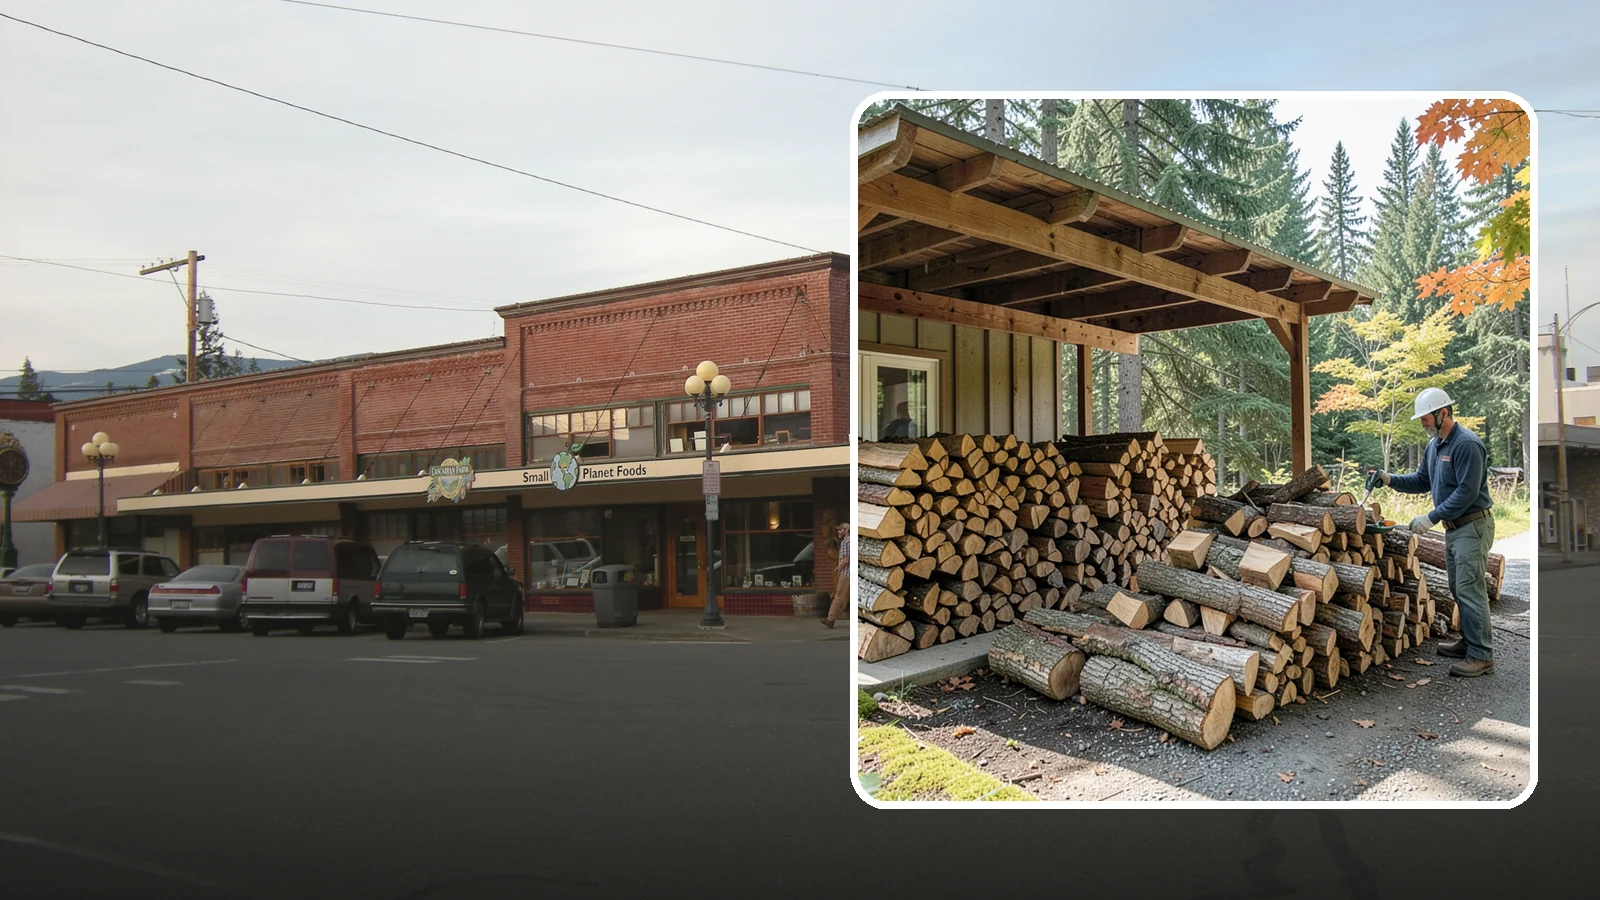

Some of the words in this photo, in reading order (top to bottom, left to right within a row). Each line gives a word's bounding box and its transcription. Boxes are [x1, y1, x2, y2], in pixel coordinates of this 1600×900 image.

[523, 471, 549, 483] Small
[582, 467, 614, 479] Planet
[616, 464, 647, 477] Foods
